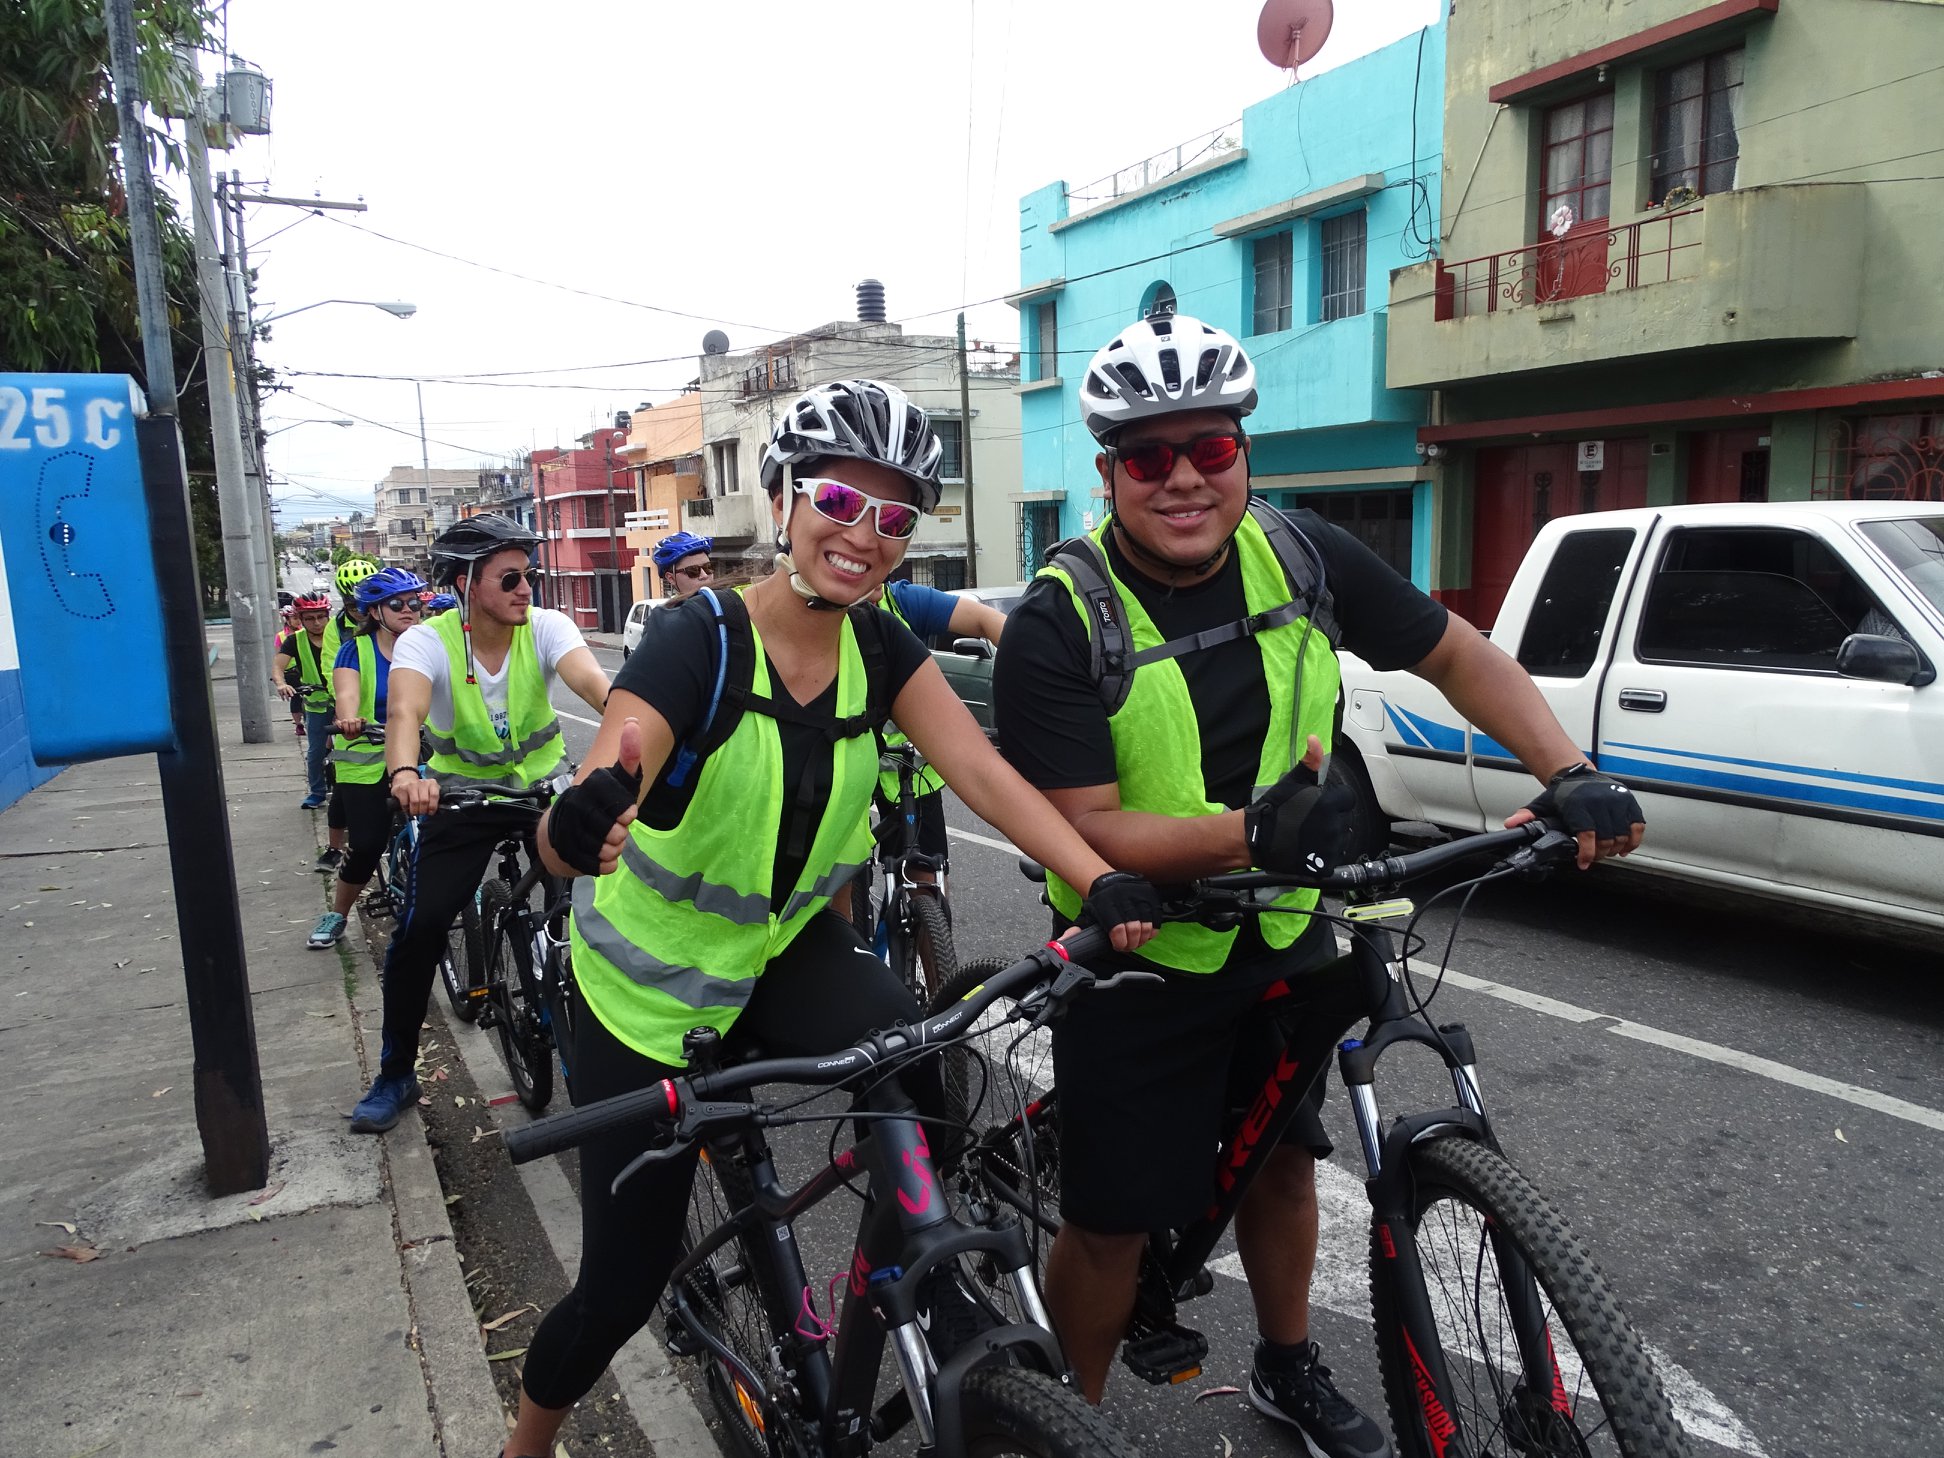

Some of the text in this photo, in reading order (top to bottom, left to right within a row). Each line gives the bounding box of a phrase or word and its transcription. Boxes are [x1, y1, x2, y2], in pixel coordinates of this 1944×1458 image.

[1099, 601, 1111, 622] TOTTO
[932, 1011, 963, 1034] CONNECT
[817, 1056, 856, 1069] CONNECT
